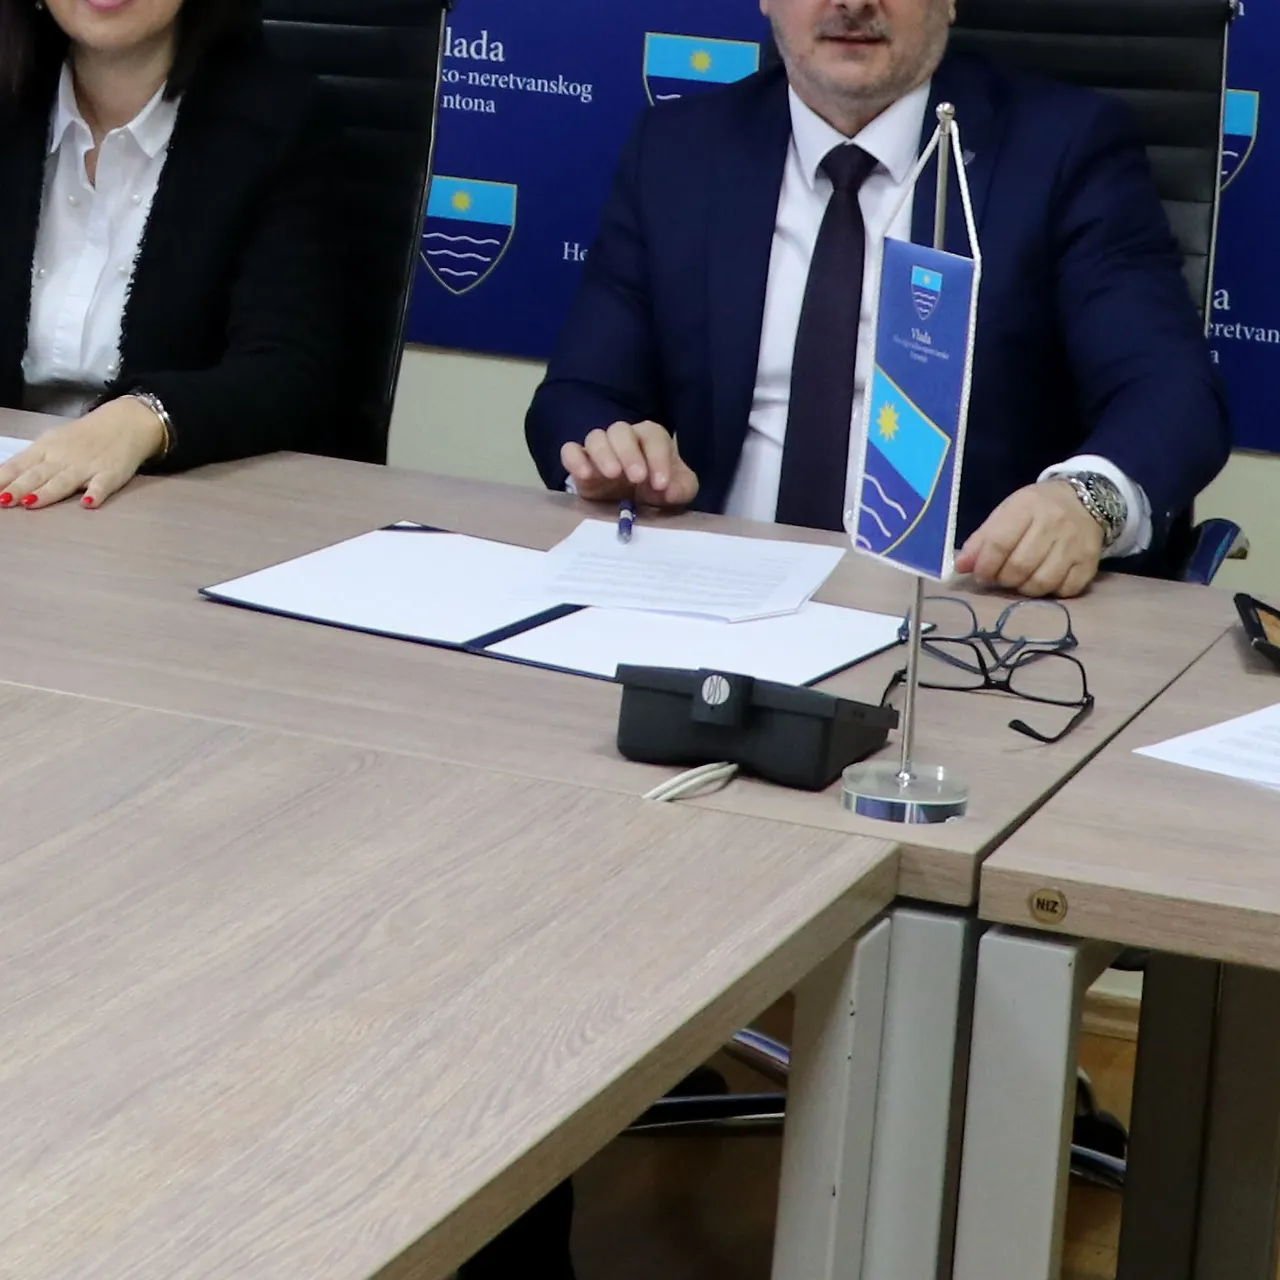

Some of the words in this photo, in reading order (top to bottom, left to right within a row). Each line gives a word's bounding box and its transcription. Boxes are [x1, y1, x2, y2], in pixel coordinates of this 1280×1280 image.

[444, 27, 505, 62] lada
[442, 69, 592, 103] o-neretvanskog
[441, 94, 495, 113] ntona
